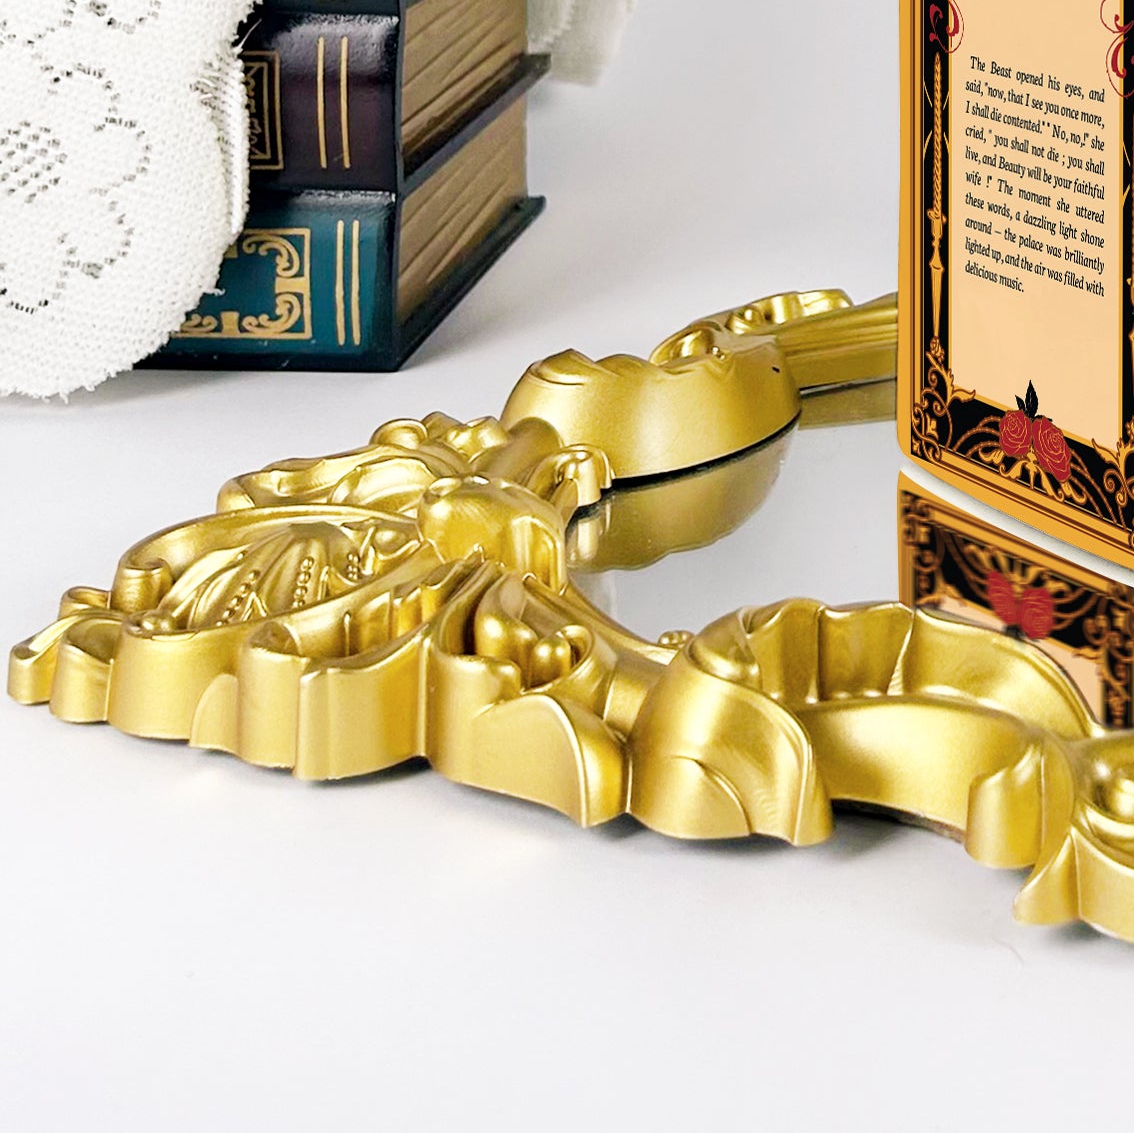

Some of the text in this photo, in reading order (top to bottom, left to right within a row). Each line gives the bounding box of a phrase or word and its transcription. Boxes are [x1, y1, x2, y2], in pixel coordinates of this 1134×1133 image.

[966, 79, 983, 96] said,
[1008, 90, 1023, 105] that
[1025, 94, 1029, 106] I
[1031, 98, 1043, 110] see
[1045, 102, 1059, 114] you
[1061, 108, 1079, 120] once
[1081, 112, 1104, 129] more,
[971, 56, 1104, 102] The Beast opened his eyes, and
[966, 101, 970, 113] I
[972, 102, 989, 118] shall
[991, 108, 1001, 122] die
[1053, 125, 1068, 143] No,
[1091, 136, 1104, 151] she
[966, 126, 986, 143] cried,
[994, 134, 1008, 147] you
[1011, 137, 1029, 153] shall
[1031, 145, 1044, 158] not
[1047, 147, 1059, 162] die
[1067, 156, 1082, 169] you
[1085, 159, 1104, 175] shall
[966, 146, 1104, 200] live, and Beauty will be your faithful
[966, 171, 981, 185] wife
[998, 179, 1013, 195] The
[1019, 188, 1051, 207] moment
[1057, 198, 1070, 213] she
[1076, 205, 1104, 224] uttered
[966, 193, 1104, 248] these words, a dazzling light shone
[966, 217, 992, 234] around
[1004, 228, 1016, 242] the
[1019, 235, 1043, 252] palace
[1046, 245, 1061, 258] was
[1065, 246, 1104, 274] brilliantly
[965, 237, 1104, 297] lighted up, and the air was filled with
[965, 260, 1024, 292] delicious music.
